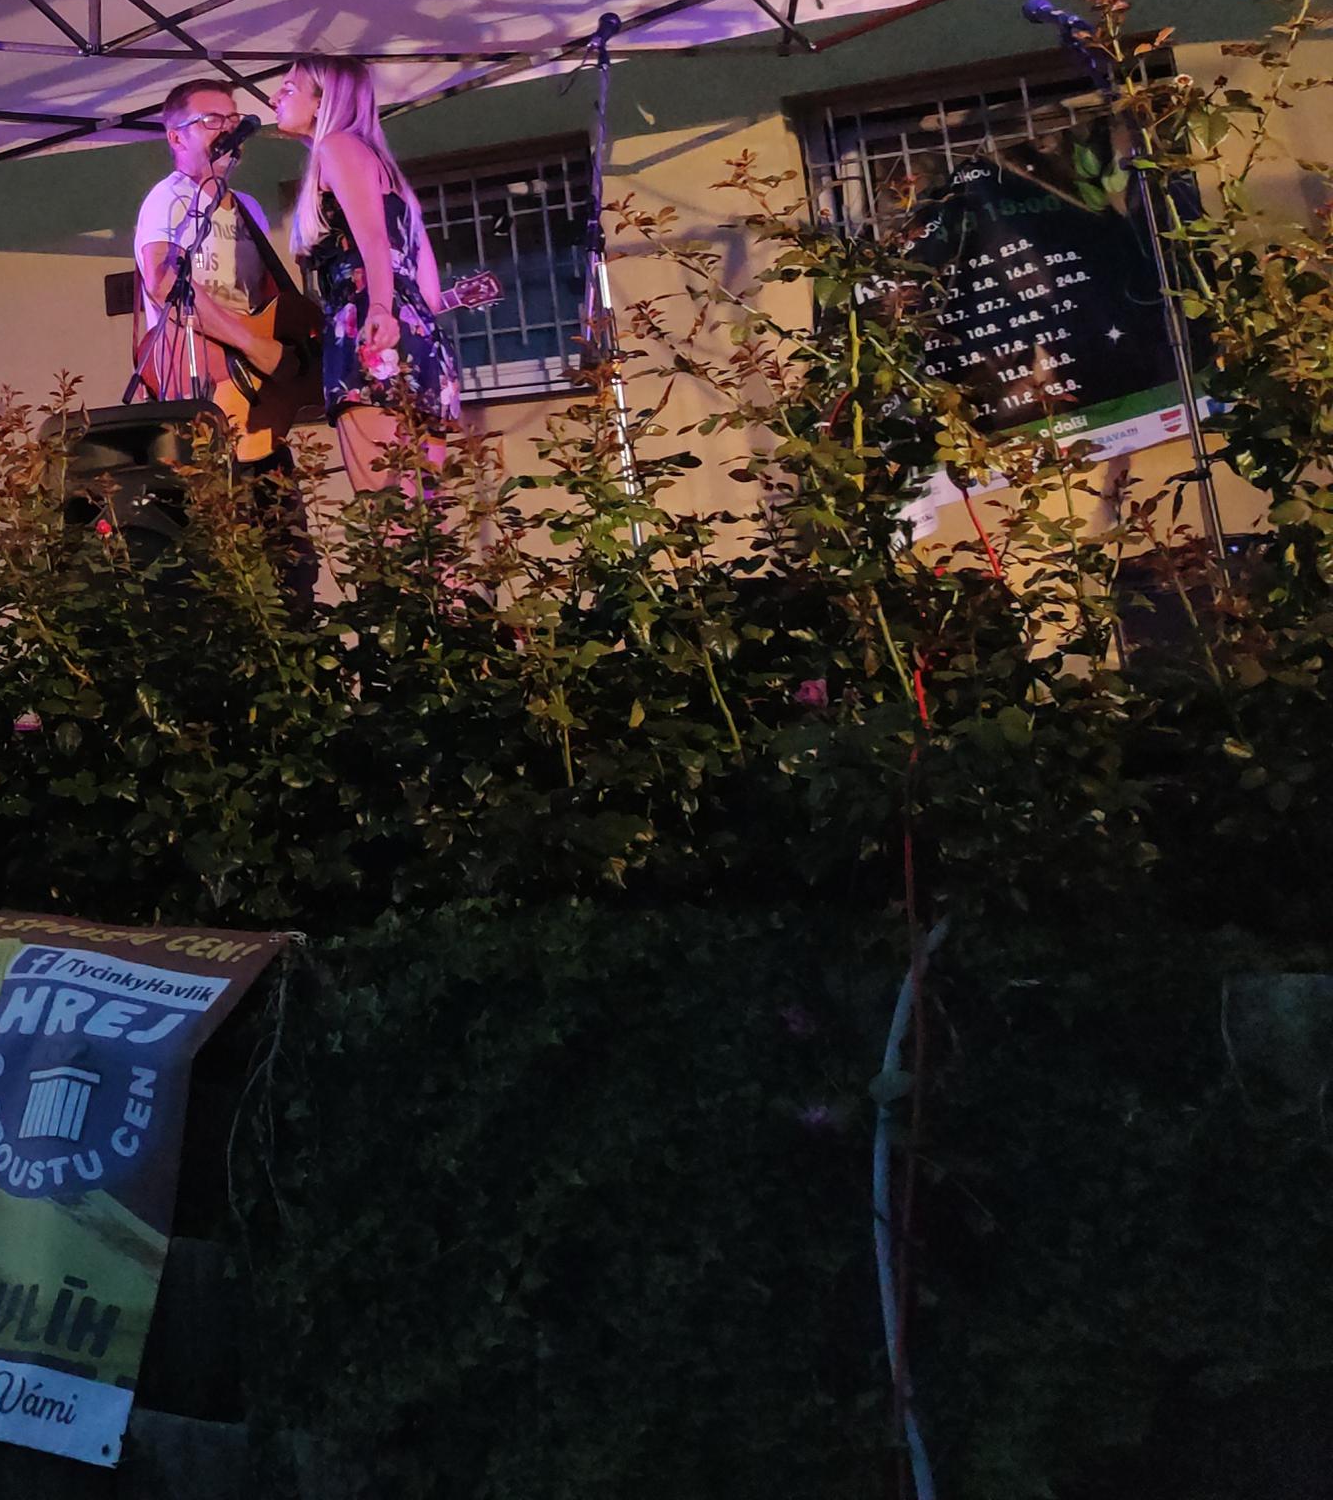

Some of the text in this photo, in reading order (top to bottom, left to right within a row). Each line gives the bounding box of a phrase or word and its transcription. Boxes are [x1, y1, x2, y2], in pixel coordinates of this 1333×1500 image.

[999, 238, 1034, 258] 23.8.
[972, 276, 999, 293] 2.8.
[1005, 262, 1039, 281] 16.8.
[1043, 251, 1083, 267] 30.8.
[936, 271, 1091, 326] 13.7. 27.7. 10.8. 24.8.
[966, 323, 1002, 340] 10.8.
[1008, 310, 1045, 329] 24.8.
[1050, 299, 1078, 315] 7.9.
[925, 327, 1072, 377] 0.7. 3.8. 17.8. 31.8.
[997, 352, 1076, 383] 12.8. 26.8.
[164, 932, 263, 964] CEN!
[111, 1065, 158, 1157] CEN
